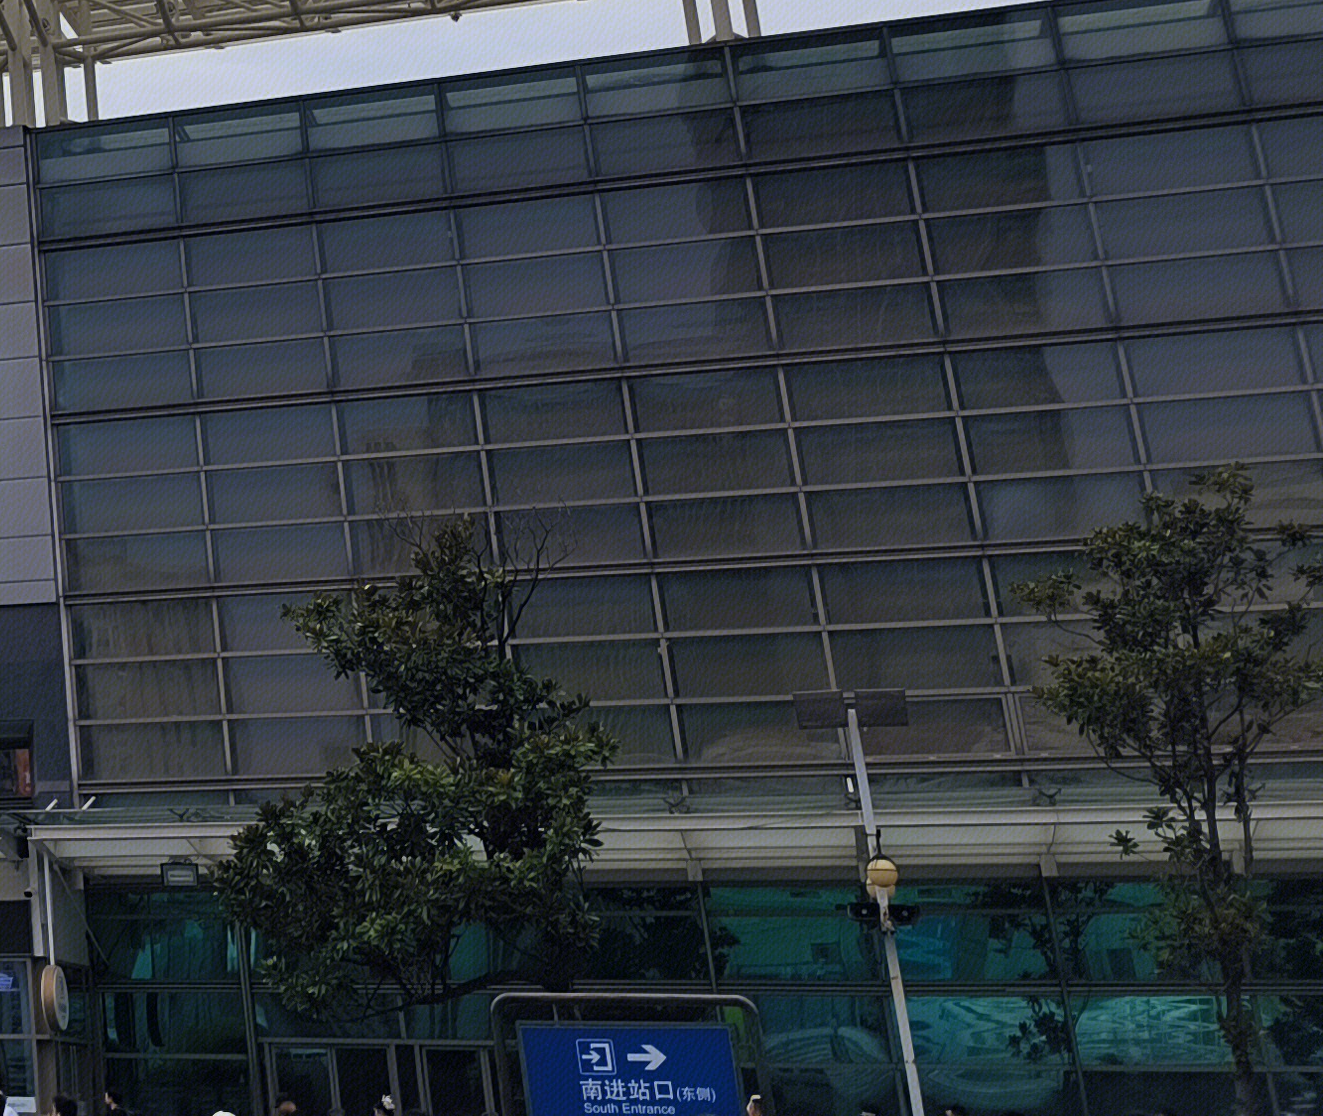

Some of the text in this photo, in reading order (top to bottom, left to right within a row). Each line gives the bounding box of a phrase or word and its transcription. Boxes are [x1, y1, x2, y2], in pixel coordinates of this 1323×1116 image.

[579, 1078, 716, 1102] 南进站口(东侧)
[584, 1102, 676, 1115] South Entrance
